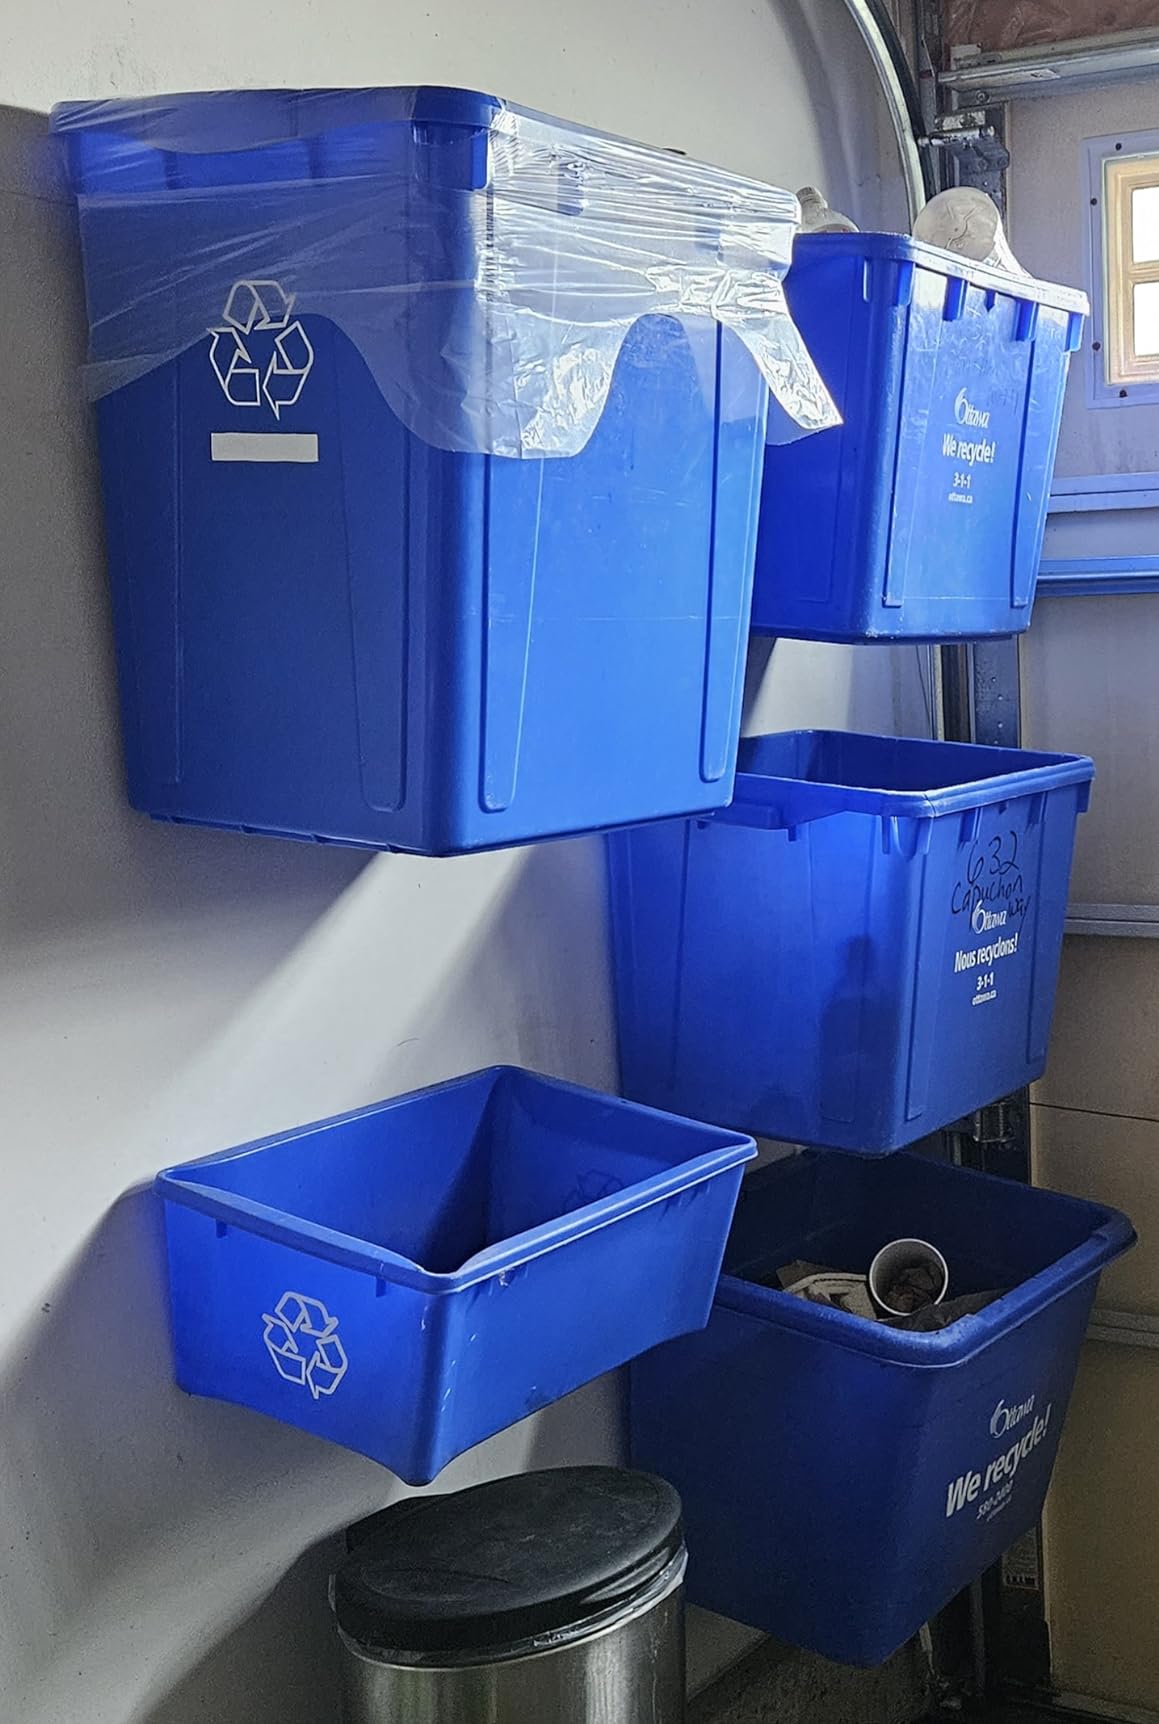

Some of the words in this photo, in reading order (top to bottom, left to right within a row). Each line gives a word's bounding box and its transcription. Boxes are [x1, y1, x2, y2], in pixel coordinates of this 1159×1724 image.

[954, 387, 990, 428] Ottawa
[942, 433, 957, 457] We
[957, 438, 995, 466] recycle!
[953, 471, 971, 488] 3-1-1
[967, 830, 1019, 884] 632
[971, 899, 1007, 934] Ottawa
[954, 949, 977, 973] Nous
[976, 932, 1019, 967] recyclons!
[976, 971, 995, 991] 3-1-1
[990, 1394, 1035, 1439] Ottawa
[945, 1470, 981, 1518] We
[983, 1402, 1052, 1492] recycle!
